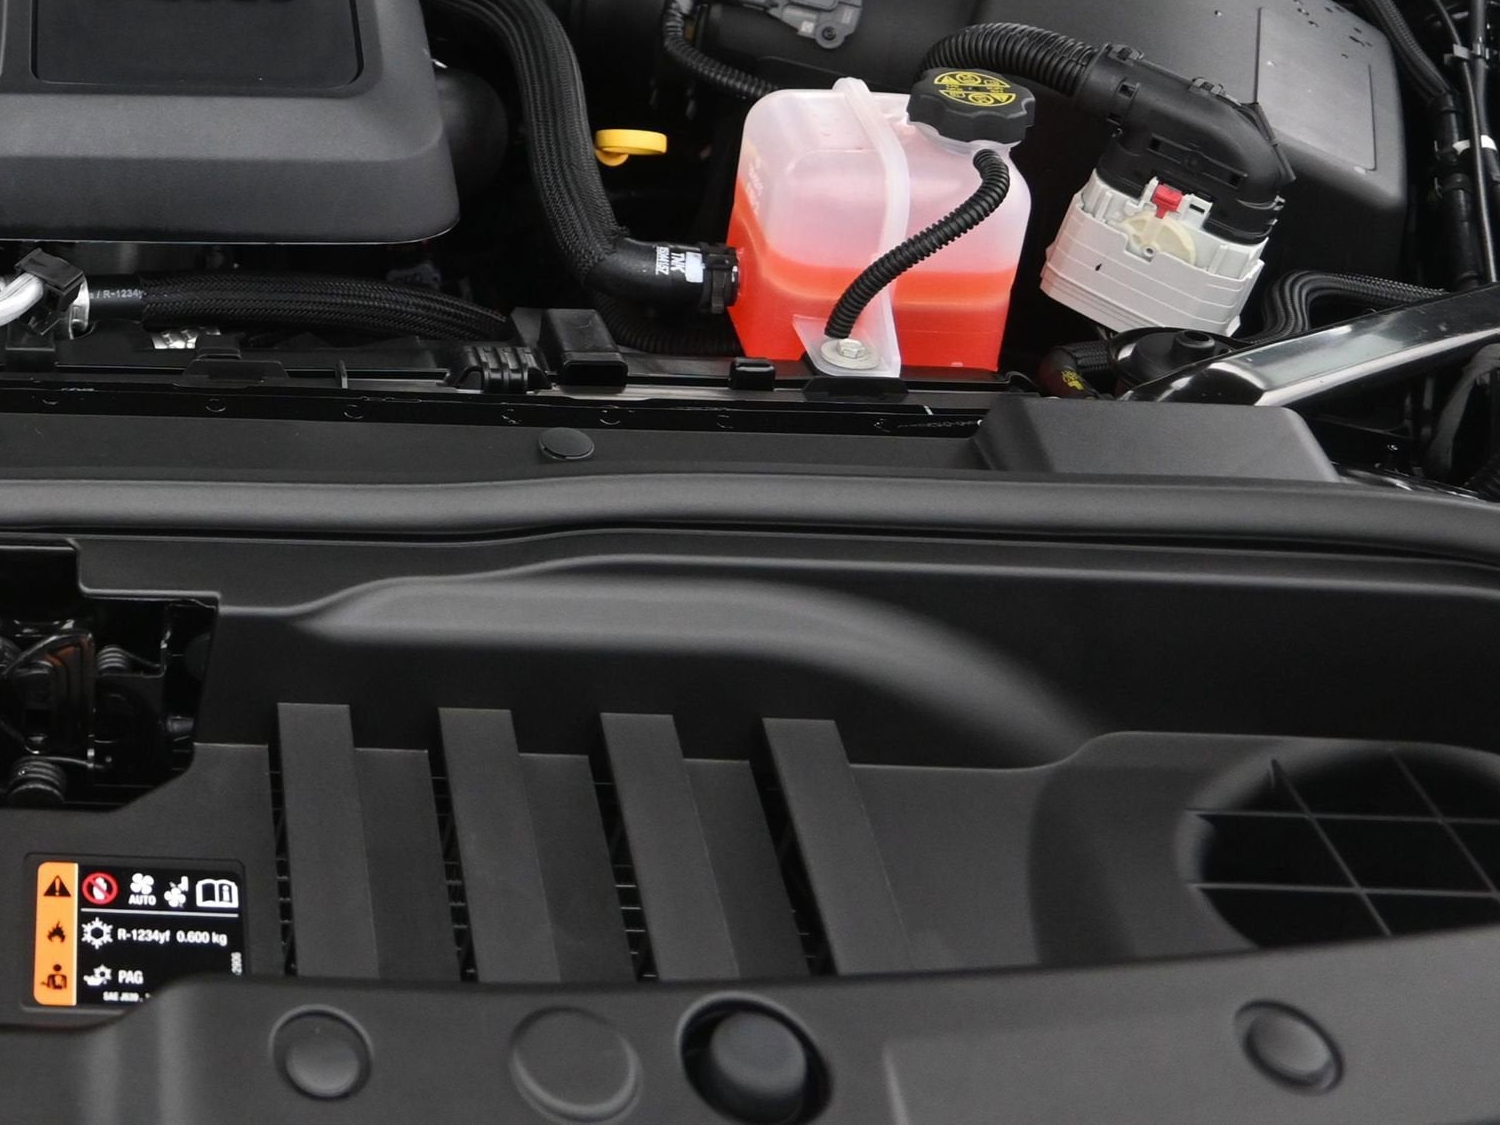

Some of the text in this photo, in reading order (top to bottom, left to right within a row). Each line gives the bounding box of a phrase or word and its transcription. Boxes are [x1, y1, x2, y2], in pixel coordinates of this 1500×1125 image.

[128, 894, 157, 906] AUTO
[117, 928, 228, 947] R-1234yf 0.600 kg
[118, 970, 143, 984] PAG
